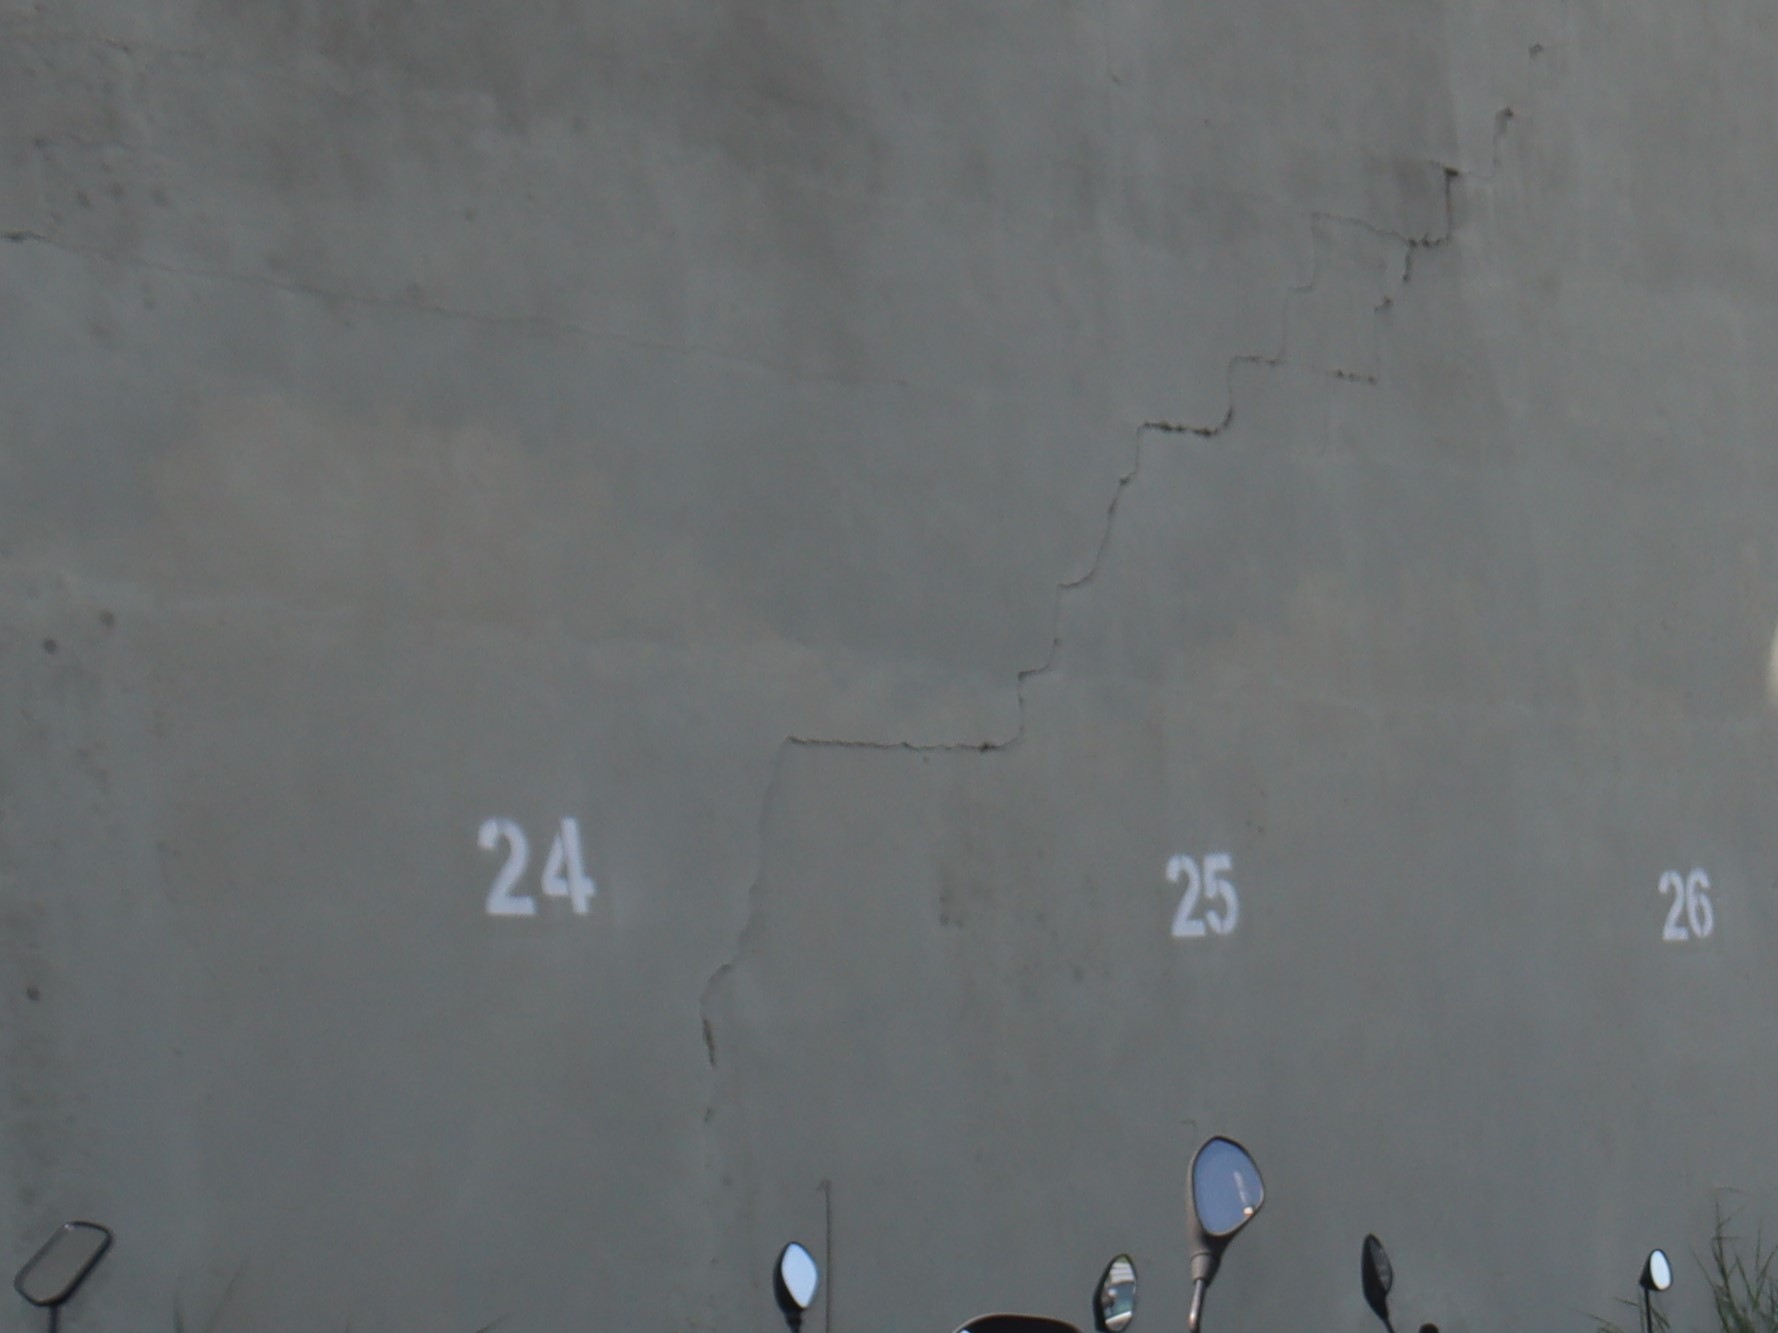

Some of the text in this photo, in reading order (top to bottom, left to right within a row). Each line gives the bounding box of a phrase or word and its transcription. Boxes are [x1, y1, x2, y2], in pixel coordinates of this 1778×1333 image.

[478, 816, 596, 915] 24
[1165, 852, 1240, 937] 25
[1657, 867, 1714, 941] 26
